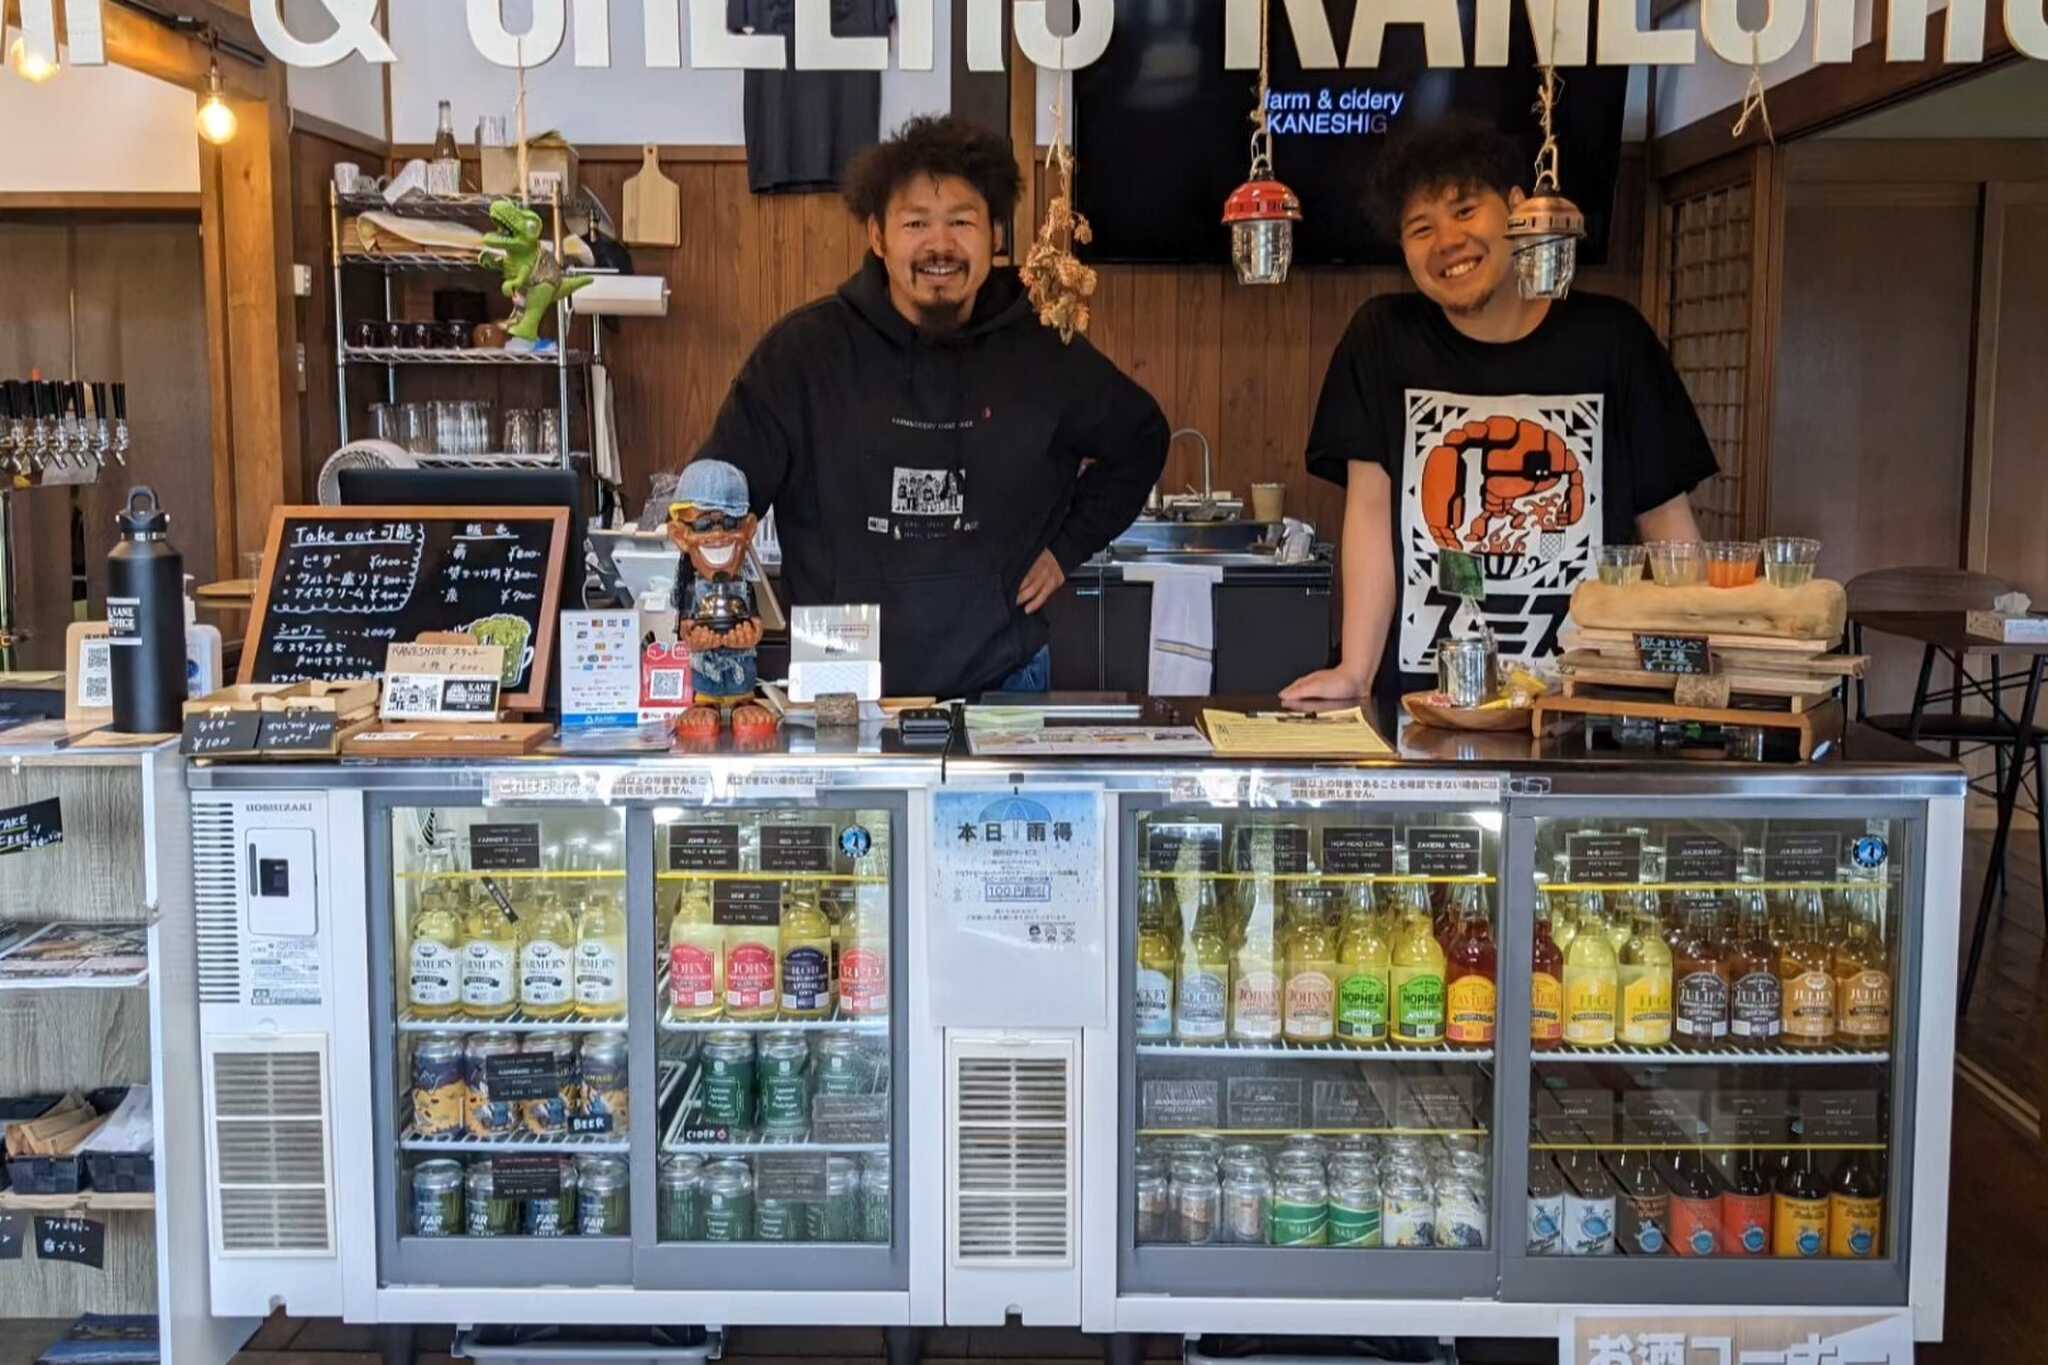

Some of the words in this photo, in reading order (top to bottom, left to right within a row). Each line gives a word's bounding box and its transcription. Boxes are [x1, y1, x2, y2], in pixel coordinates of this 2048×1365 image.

[1264, 88, 1310, 109] farm
[1318, 88, 1332, 109] &
[1340, 88, 1404, 114] cidery
[295, 525, 335, 542] Take
[345, 530, 375, 541] out
[246, 803, 312, 812] HOSHIZAKI
[958, 822, 1002, 842] 本日
[733, 961, 768, 975] JOHN
[573, 1117, 605, 1131] BEER
[686, 1129, 716, 1139] CIDER
[420, 1214, 443, 1225] FAR
[536, 1213, 559, 1225] FAR
[584, 1216, 605, 1228] FAR
